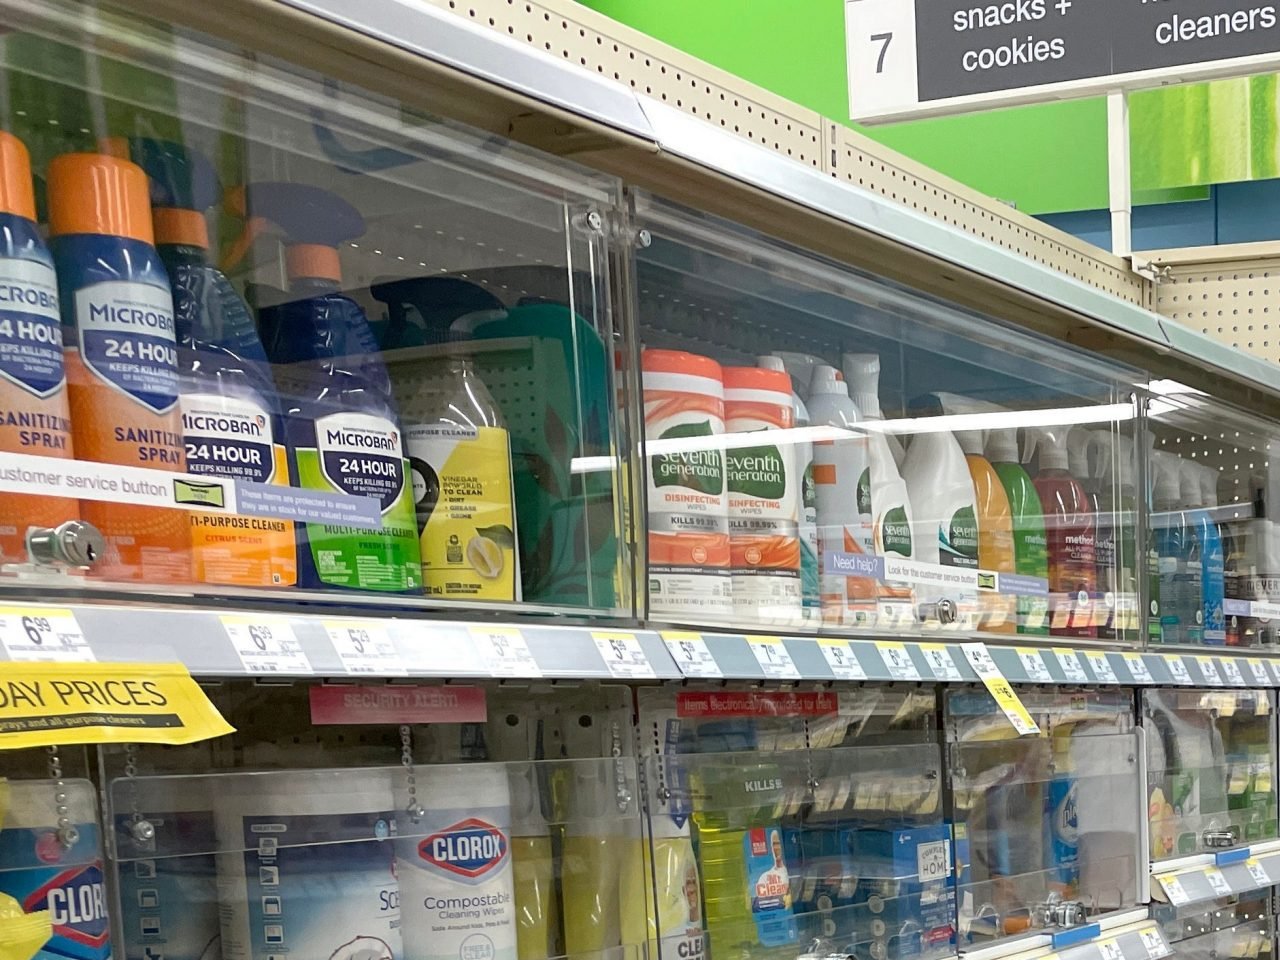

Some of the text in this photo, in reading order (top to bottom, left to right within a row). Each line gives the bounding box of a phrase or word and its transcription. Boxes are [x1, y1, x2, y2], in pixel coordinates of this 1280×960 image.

[953, 0, 1046, 32] snacks
[1155, 4, 1277, 45] cleaners
[869, 32, 894, 74] 7
[962, 36, 1066, 73] cookies
[104, 339, 135, 358] 24
[20, 431, 66, 449] SPRAY
[327, 429, 396, 451] MICROBAN
[139, 447, 181, 464] SPRAY
[186, 443, 262, 465] 24 HOUR
[190, 463, 214, 474] KEEPS
[216, 465, 244, 475] KILLING
[339, 458, 397, 478] 24 HOUR
[661, 463, 721, 479] generation
[726, 456, 780, 473] eventh
[0, 467, 167, 497] ustomer service button
[343, 477, 363, 486] KEEPS
[727, 470, 781, 484] eneration
[455, 489, 483, 497] CLEAN
[665, 493, 721, 506] DISINFECTING
[687, 503, 707, 512] WIPES
[740, 507, 762, 516] WIPES
[251, 519, 286, 533] CLEANER
[671, 516, 694, 526] KILLS
[1065, 534, 1094, 546] method
[833, 554, 879, 573] Need help?
[888, 565, 976, 584] Look for the customer service button
[49, 681, 168, 709] PRICES
[343, 692, 459, 709] SECURITY ALERT!
[684, 698, 709, 712] Items
[27, 715, 146, 730] and all-purpose cleaners
[745, 779, 776, 794] KILLS
[432, 834, 501, 863] CLOROX
[756, 881, 788, 899] Clean
[424, 891, 511, 910] Compostable
[438, 908, 479, 920] Cleaning
